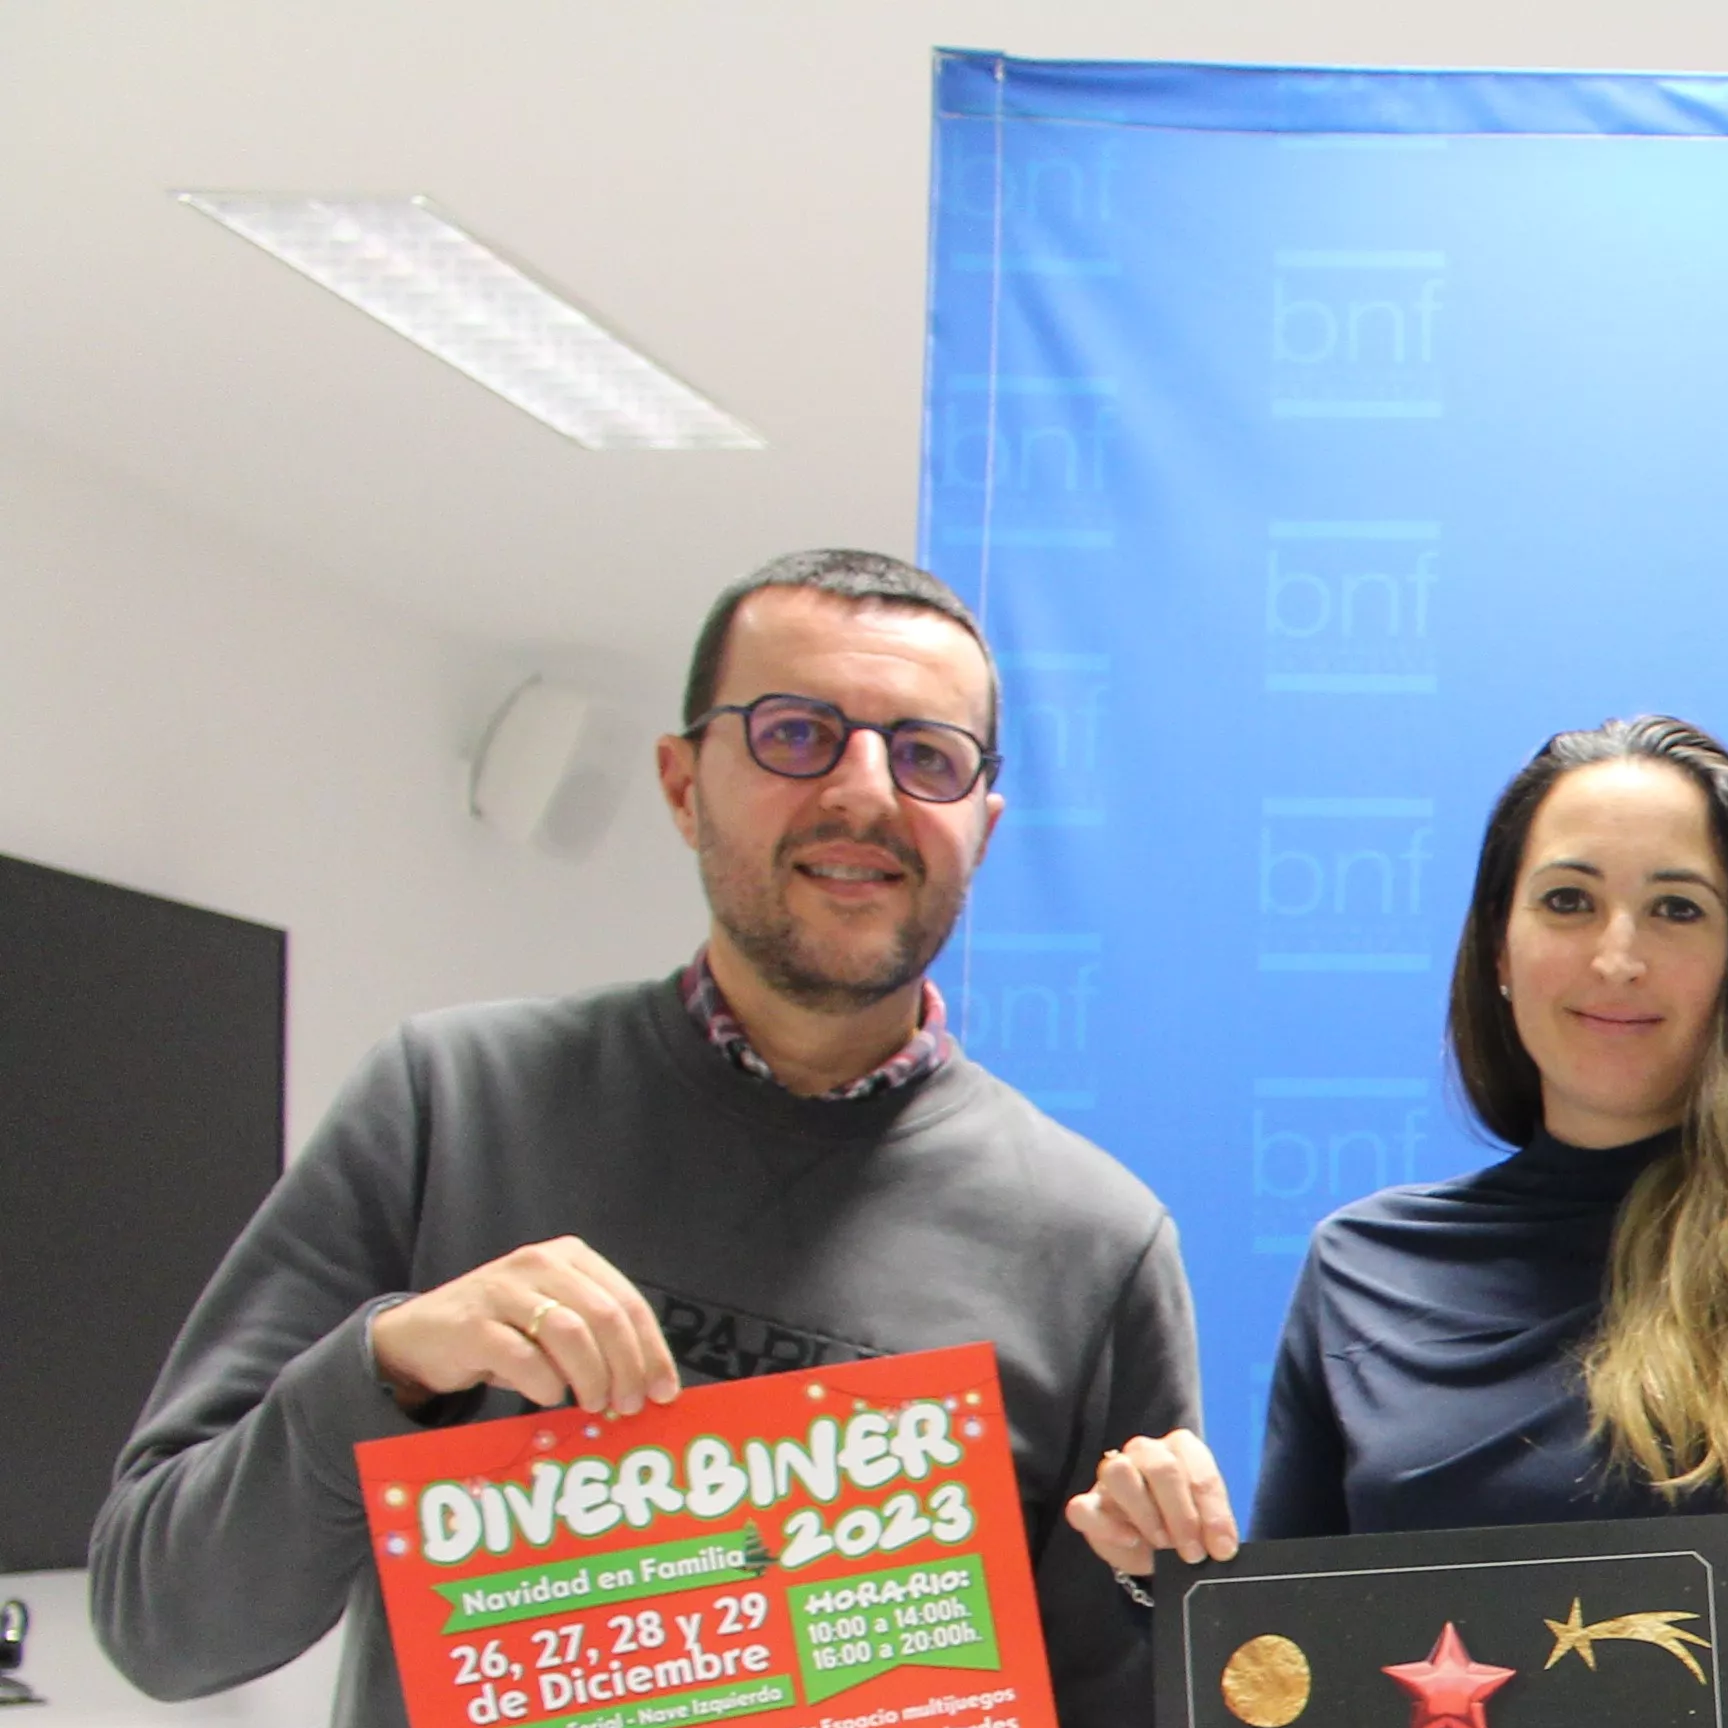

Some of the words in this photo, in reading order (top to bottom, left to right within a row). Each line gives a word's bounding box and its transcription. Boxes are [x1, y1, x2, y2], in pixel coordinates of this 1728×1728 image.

[419, 1400, 963, 1564] DIVERBINER
[780, 1484, 974, 1568] 2023
[461, 1568, 592, 1616] Navidad
[597, 1568, 636, 1590] en
[639, 1545, 747, 1583] Familia
[804, 1569, 971, 1616] HORARIO:
[449, 1639, 523, 1689] 26,
[531, 1623, 599, 1679] 27,
[607, 1610, 666, 1654] 28
[675, 1613, 703, 1654] y
[713, 1592, 768, 1635] 29
[807, 1614, 869, 1645] 10:00
[873, 1617, 890, 1634] a
[811, 1640, 874, 1670] 16:00
[878, 1642, 895, 1659] a
[467, 1676, 528, 1725] de
[538, 1642, 770, 1710] Diciembre
